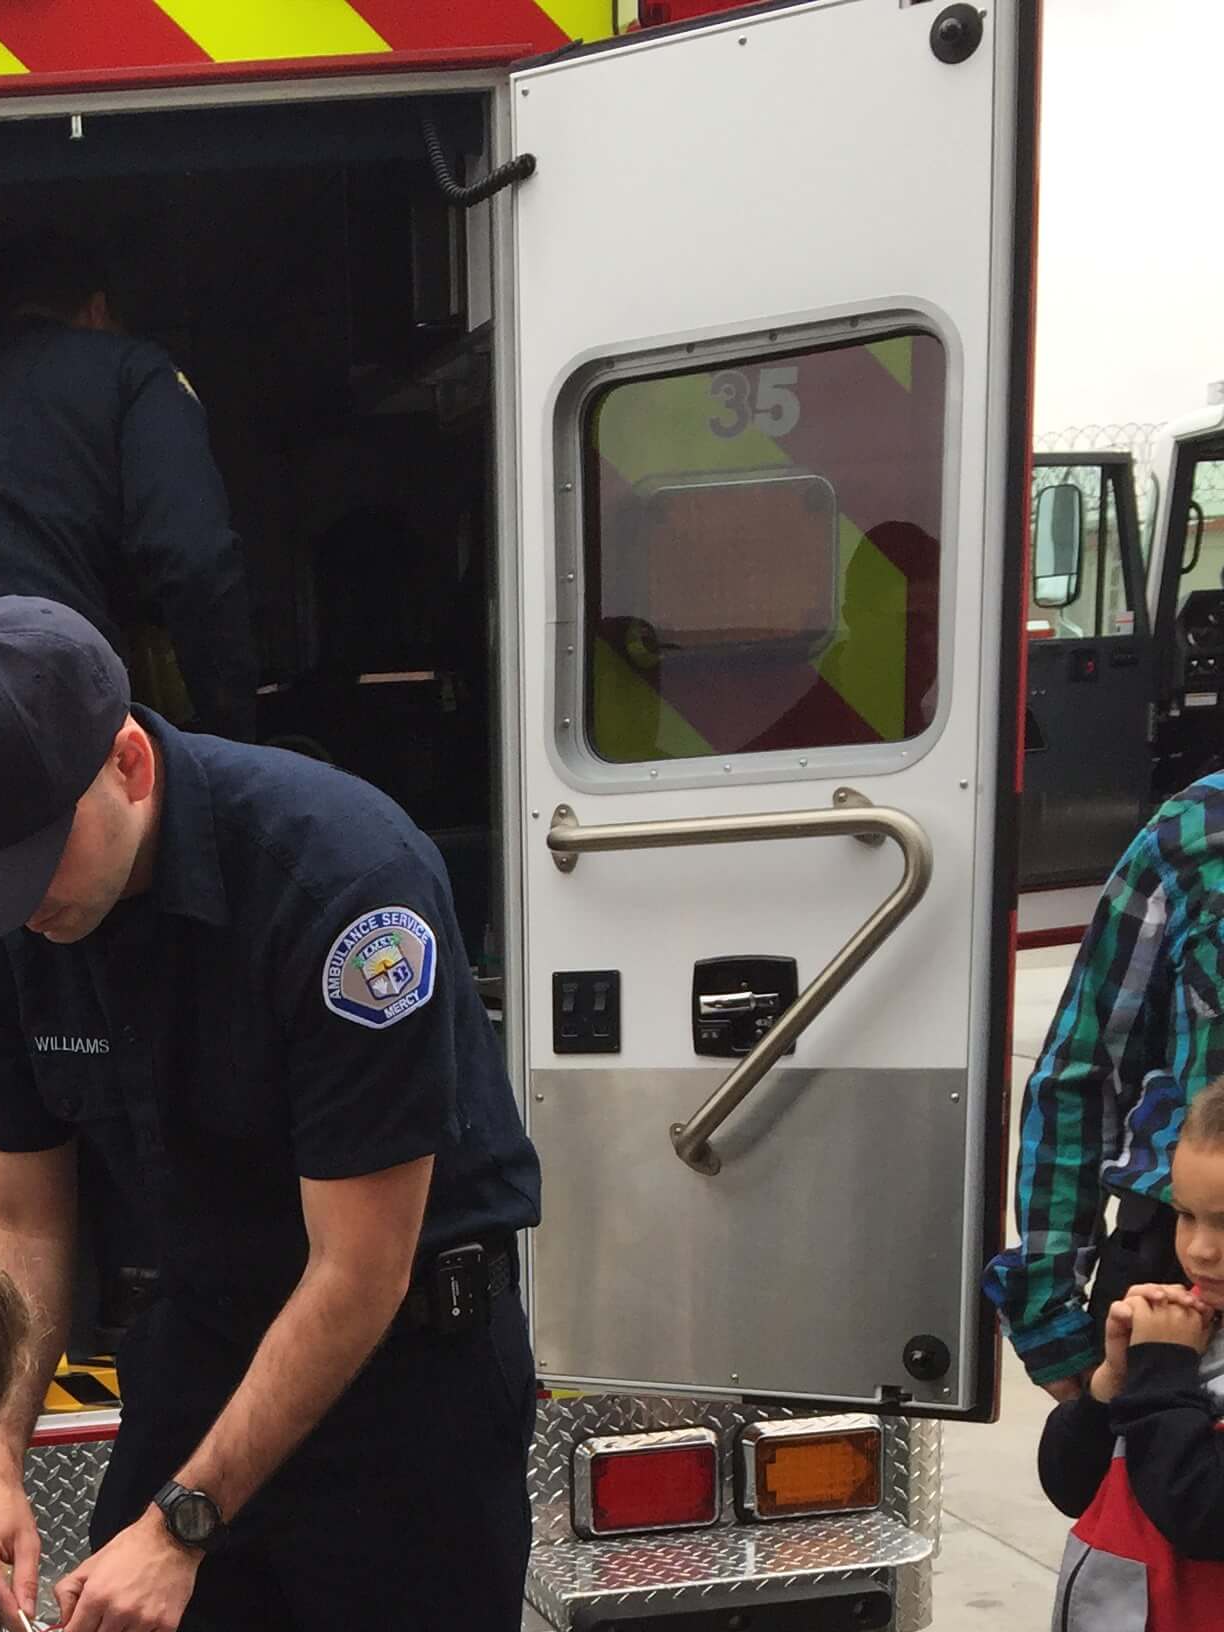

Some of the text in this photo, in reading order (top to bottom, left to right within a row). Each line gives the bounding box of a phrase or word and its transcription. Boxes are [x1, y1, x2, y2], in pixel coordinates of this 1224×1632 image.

[709, 367, 801, 438] 35
[327, 916, 379, 1000] AMBULANCE
[382, 912, 429, 945] SERVICE
[384, 989, 420, 1019] MERCY
[34, 1036, 111, 1054] WILLIAMS
